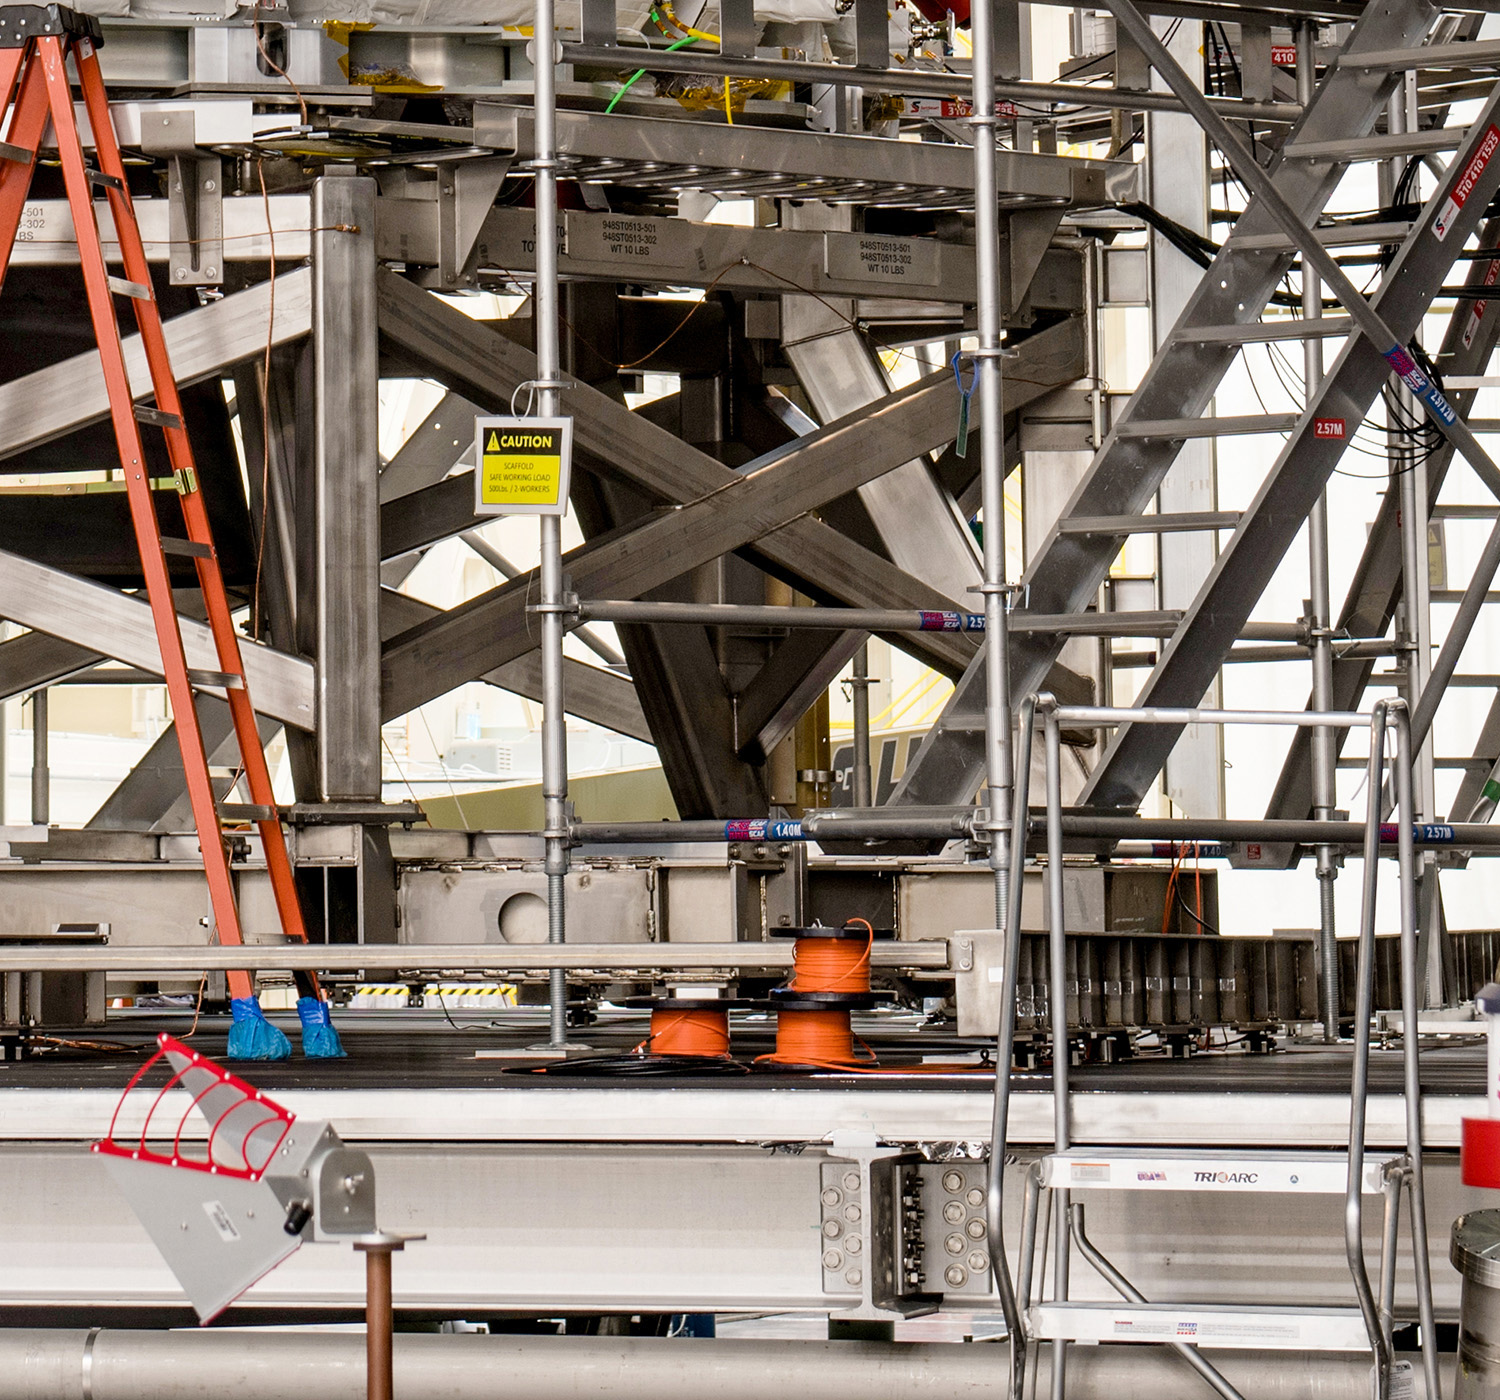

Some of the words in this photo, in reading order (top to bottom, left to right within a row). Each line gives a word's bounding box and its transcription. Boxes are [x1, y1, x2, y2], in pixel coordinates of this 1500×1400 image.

[1274, 53, 1294, 62] 410
[1457, 178, 1472, 202] 310
[1470, 160, 1485, 181] 410
[1481, 133, 1499, 160] 1525
[602, 220, 656, 234] 948ST0513-501
[602, 232, 657, 245] 948ST0513-302
[610, 244, 622, 254] WT
[625, 245, 633, 254] 10
[635, 246, 650, 256] LBS
[859, 241, 911, 253] 948ST0513-501
[860, 252, 912, 264] 948ST0513-302
[867, 264, 879, 273] WT
[881, 264, 889, 274] 10
[891, 265, 905, 275] LBS
[1317, 422, 1343, 435] 2.57M
[500, 435, 553, 449] CAUTION
[504, 462, 535, 471] SCAFFOLD
[489, 473, 502, 482] SAFE
[503, 473, 532, 482] WORKING
[533, 473, 551, 482] LOAD
[970, 616, 986, 629] 2.57
[775, 822, 802, 836] 1.40M
[1427, 826, 1452, 839] 2.57M
